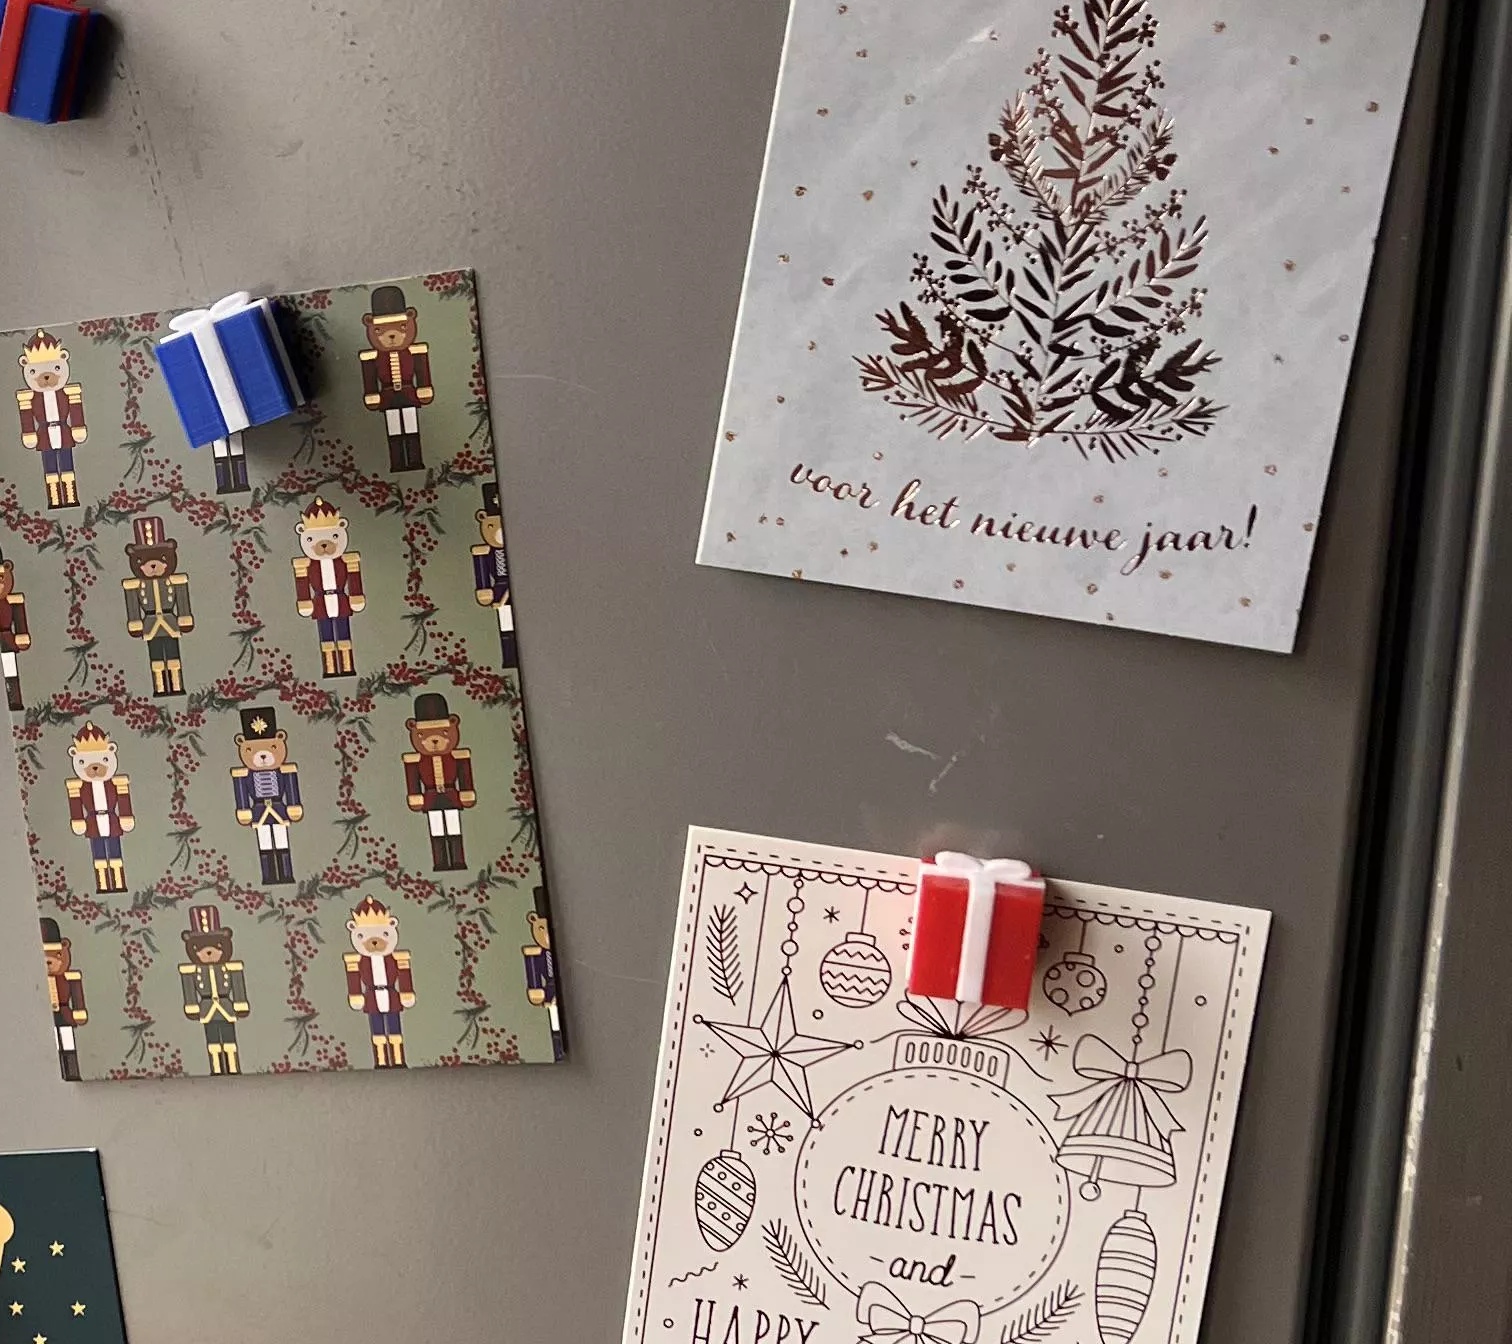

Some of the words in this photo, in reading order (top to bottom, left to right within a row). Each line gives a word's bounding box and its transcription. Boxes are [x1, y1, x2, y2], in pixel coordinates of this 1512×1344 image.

[790, 462, 879, 508] voor
[891, 479, 961, 529] het
[970, 511, 1126, 551] nieuwe
[1120, 504, 1258, 575] jaar!
[879, 1104, 990, 1171] MERRY
[834, 1165, 1021, 1245] CHRISTMAS
